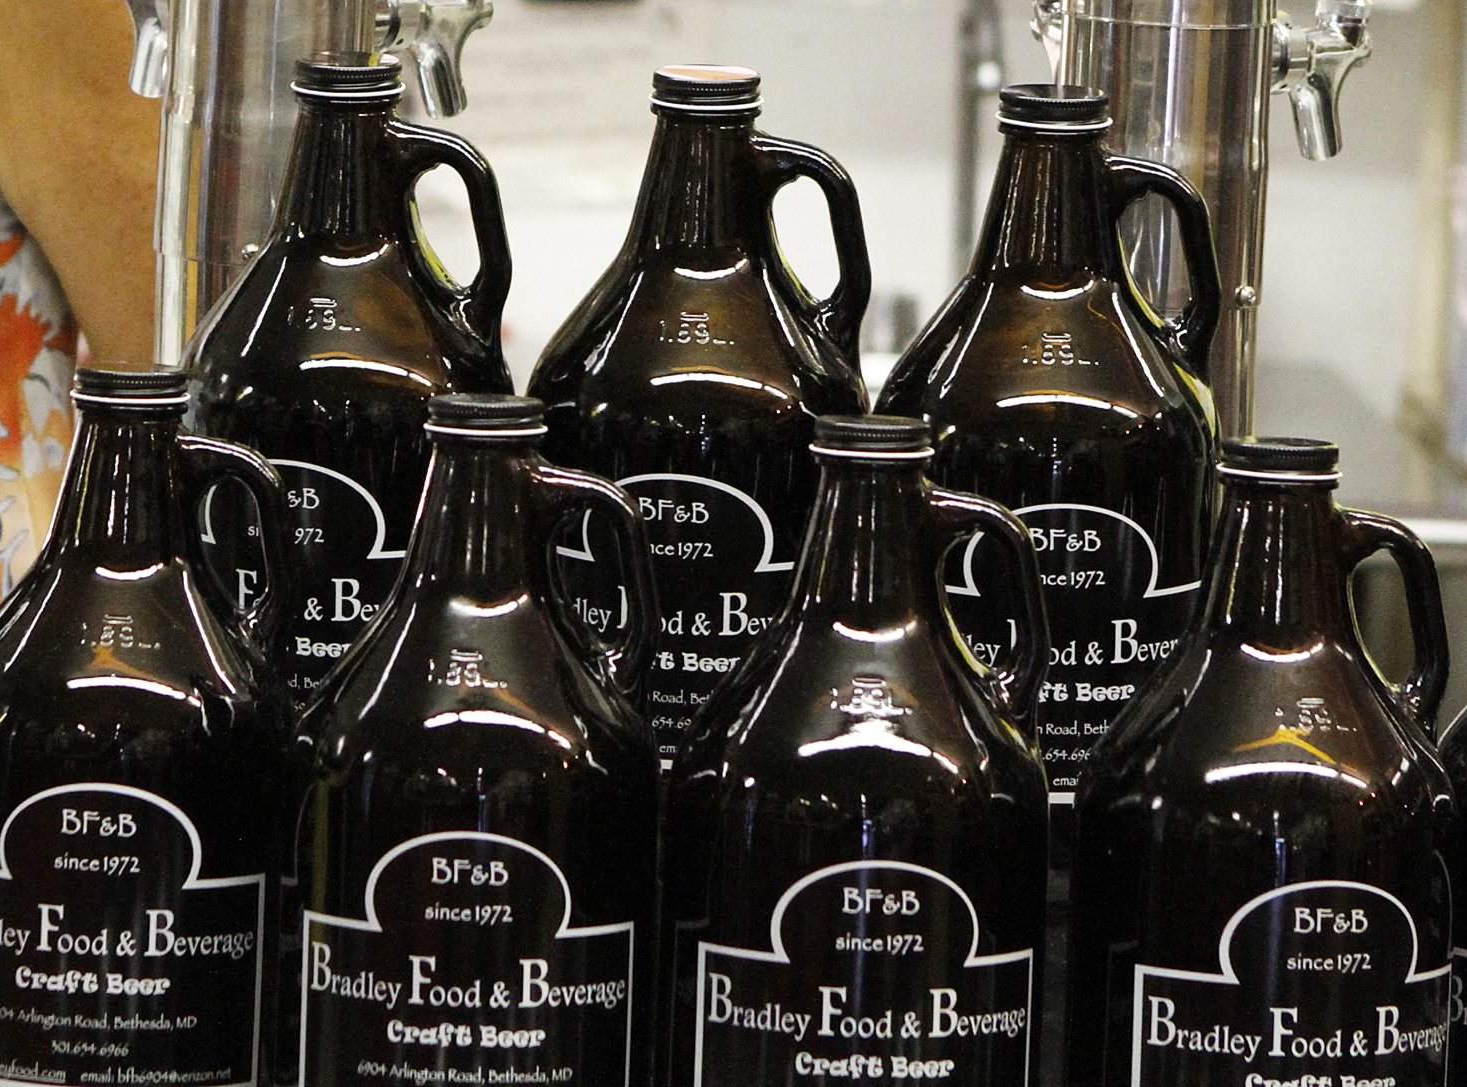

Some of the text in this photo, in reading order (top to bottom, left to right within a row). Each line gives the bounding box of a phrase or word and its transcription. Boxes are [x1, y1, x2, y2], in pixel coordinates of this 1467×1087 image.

[638, 496, 710, 524] BF&B
[294, 527, 325, 545] 972
[1070, 570, 1106, 589] 1972
[691, 611, 711, 636] &
[1084, 640, 1104, 666] &
[1075, 682, 1136, 703] Beer
[1045, 722, 1081, 737] Road,
[61, 808, 138, 838] BF&B
[53, 852, 142, 877] since 1972
[430, 856, 510, 886] BF&B
[424, 902, 514, 926] since 1972
[841, 886, 921, 916] BF&B
[36, 903, 109, 956] Food
[115, 931, 137, 957] &
[144, 908, 254, 960] Beverage
[1293, 906, 1370, 934] BF&B
[835, 931, 925, 955] since 1972
[310, 941, 626, 1010] Bradley Food & Beverage
[1286, 953, 1372, 974] since 1972
[15, 965, 172, 996] Craft Beer
[708, 972, 1026, 1042] Bradley Food & Beverage
[176, 1015, 198, 1029] MD
[386, 1019, 547, 1049] Craft Beer
[1147, 994, 1263, 1063] Bradley
[1268, 1005, 1343, 1059] Food
[1349, 1029, 1369, 1058] &
[389, 1061, 446, 1083] Arlington
[447, 1065, 485, 1084] Road,
[551, 1067, 574, 1082] MD
[794, 1051, 955, 1080] Craft Beer
